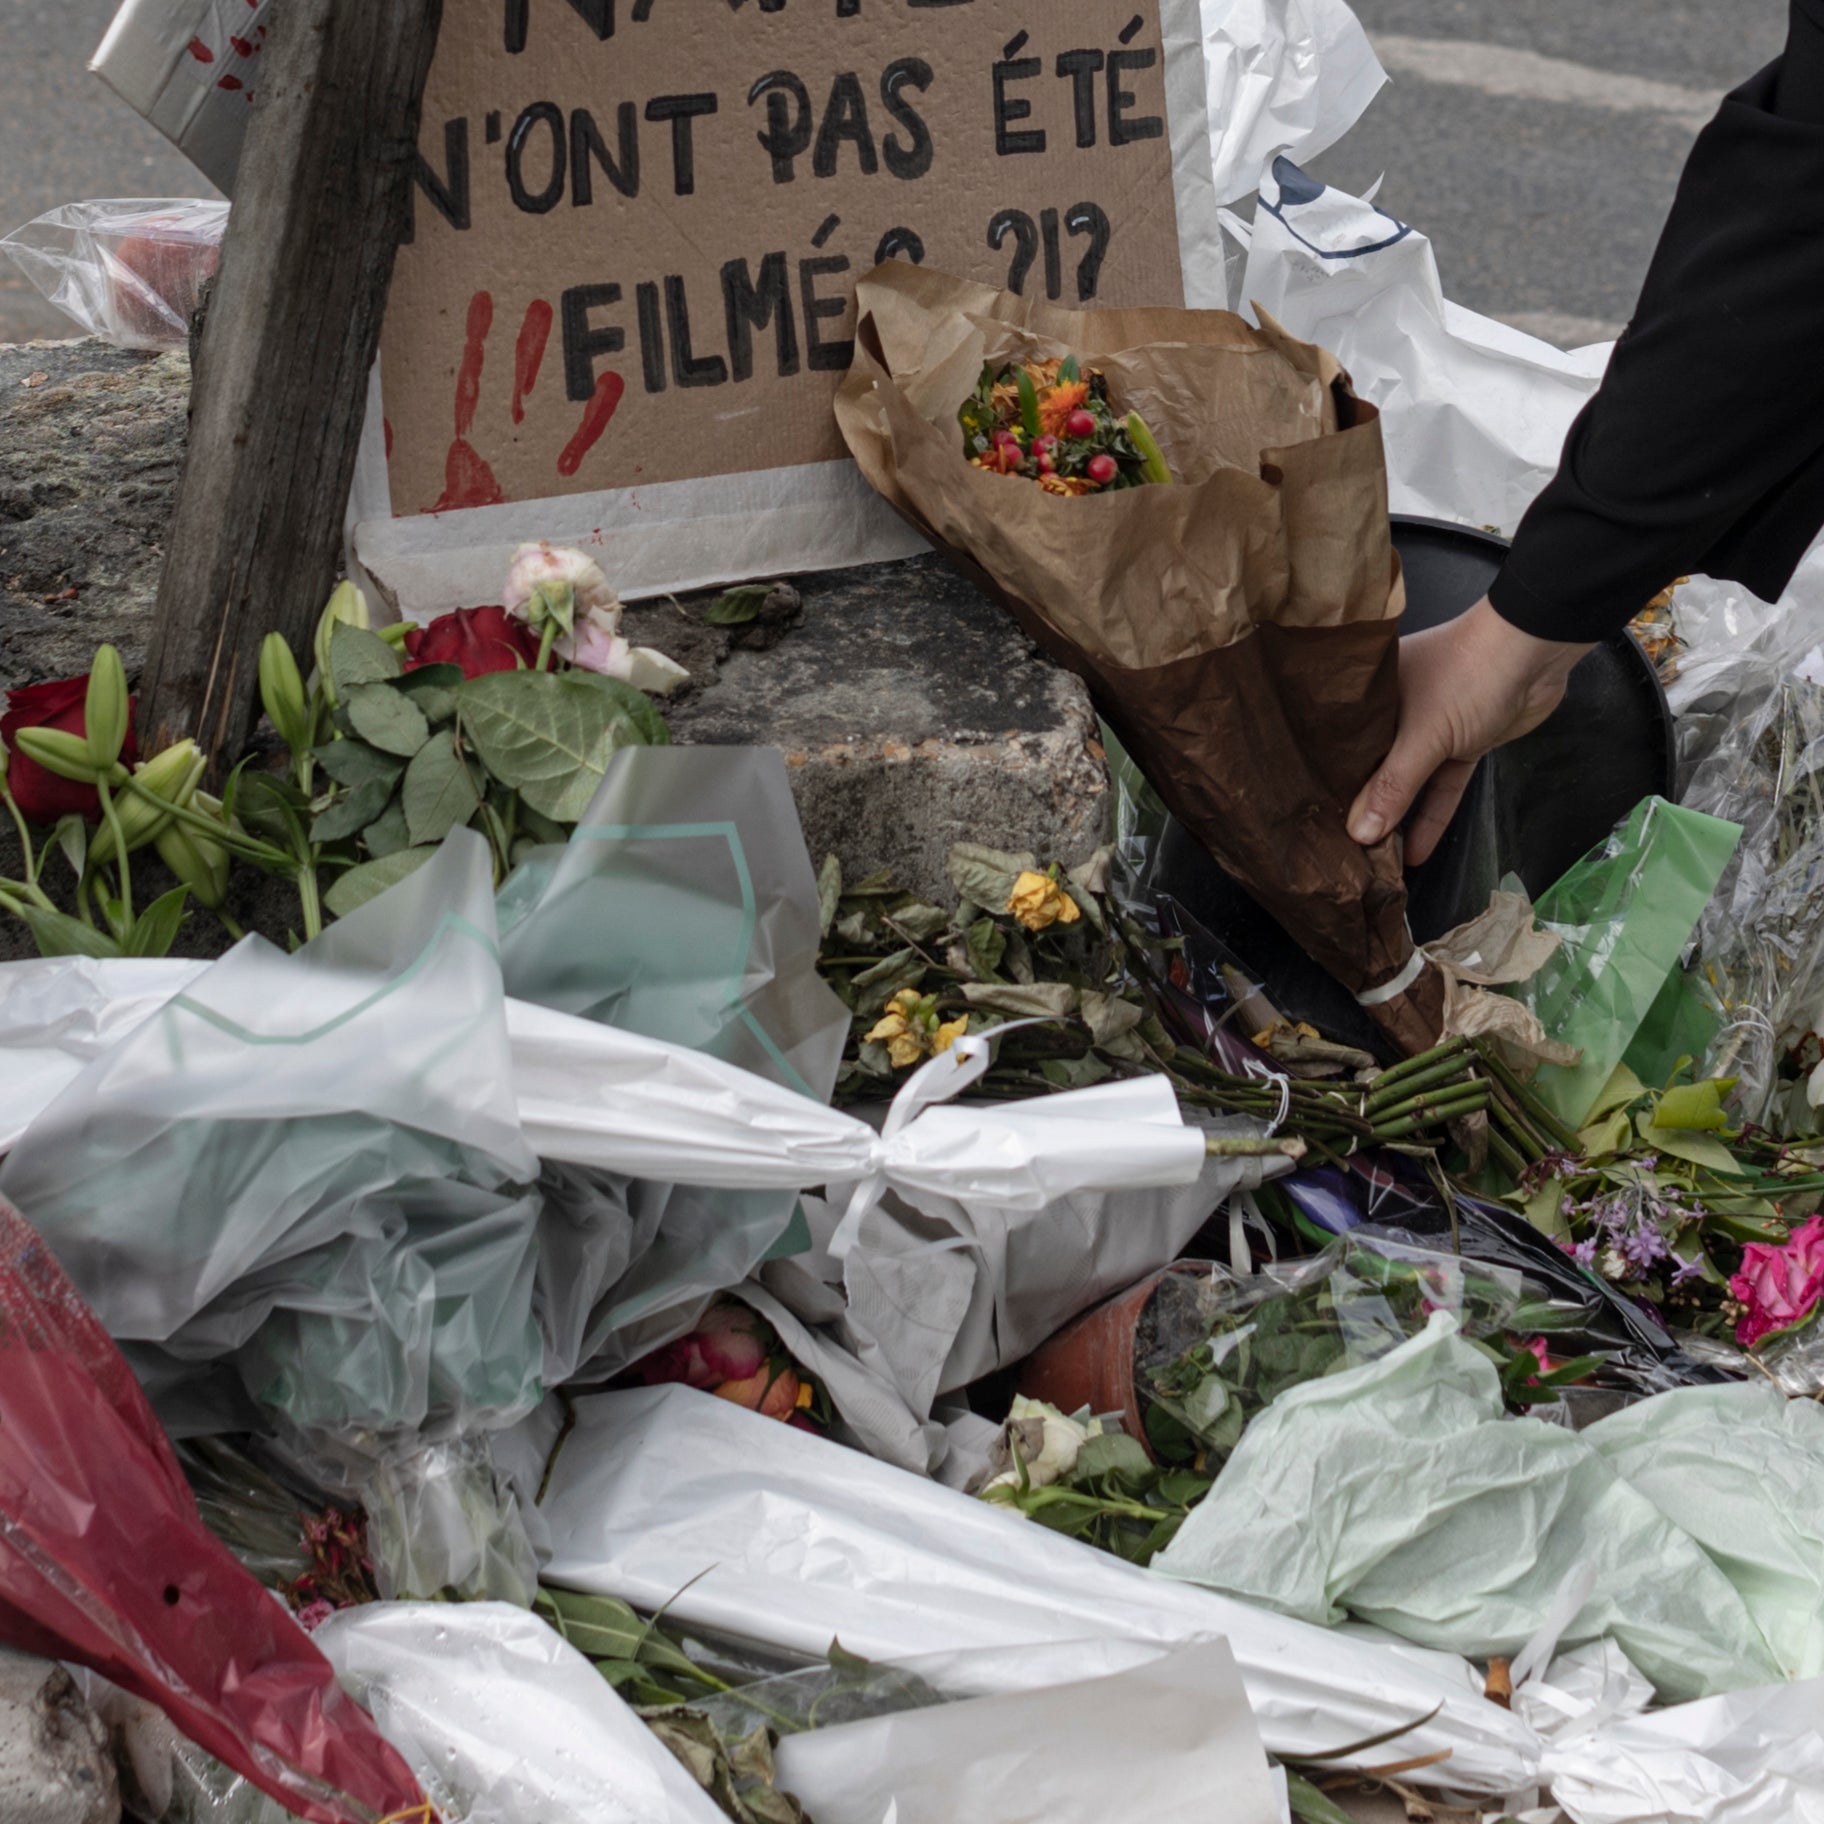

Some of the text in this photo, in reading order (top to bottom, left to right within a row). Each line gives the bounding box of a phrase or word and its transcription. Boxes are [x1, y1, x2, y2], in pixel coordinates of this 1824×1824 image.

[398, 15, 1164, 245] N'ONT PAS ÉTÉ
